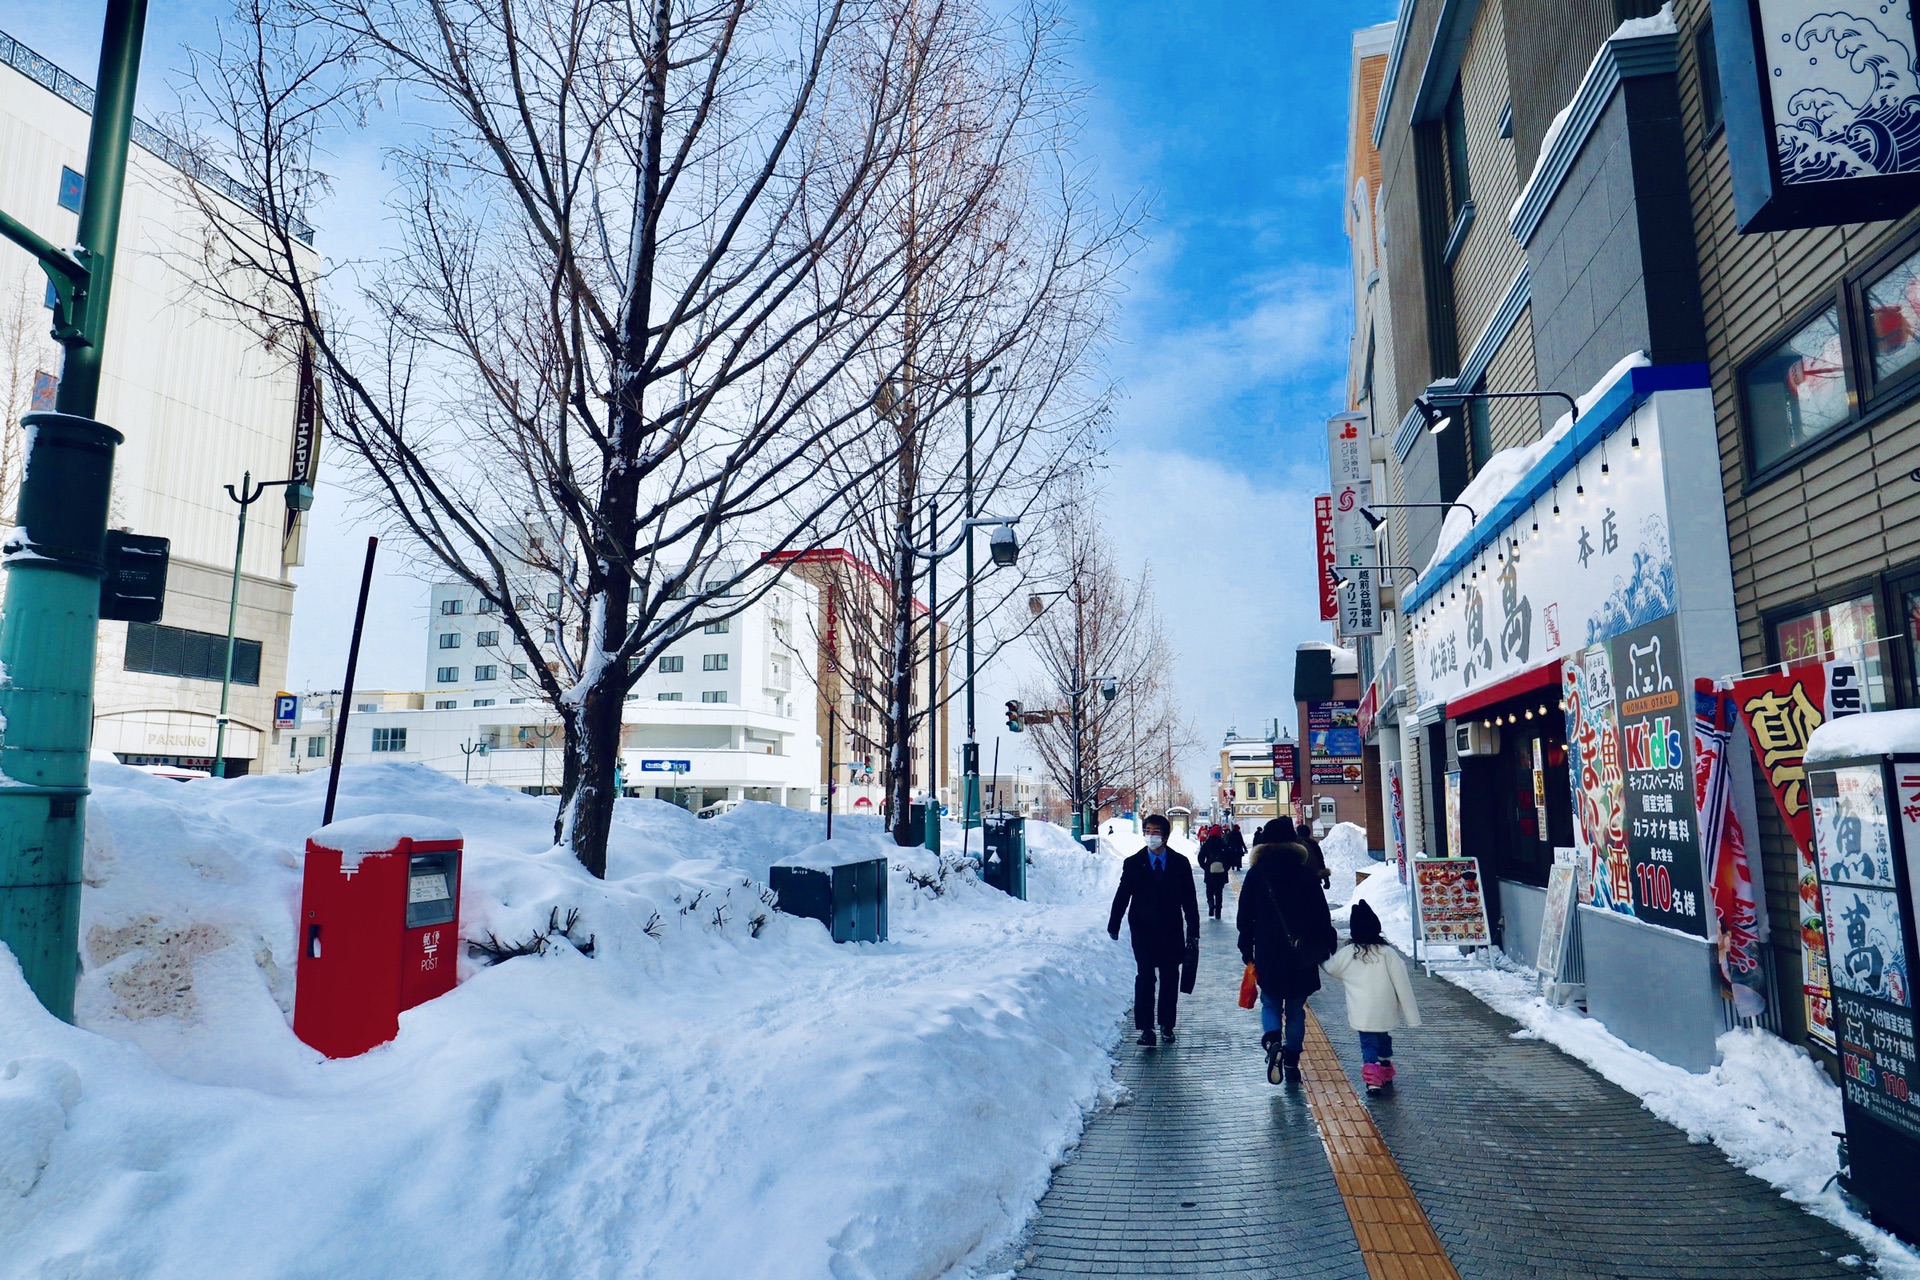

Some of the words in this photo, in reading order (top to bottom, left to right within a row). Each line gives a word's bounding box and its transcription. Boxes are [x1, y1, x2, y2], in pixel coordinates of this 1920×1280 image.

[294, 422, 309, 484] HAPPY
[1341, 442, 1350, 473] クリニック
[1352, 506, 1362, 544] クリニック
[1577, 507, 1618, 569] 本店
[1346, 582, 1358, 628] クリニック
[1358, 570, 1373, 628] 越前谷脳神経
[1463, 537, 1532, 688] 魚萬
[1430, 632, 1458, 682] 北海道
[279, 699, 294, 718] P
[1626, 700, 1648, 712] UOMAN
[1651, 695, 1673, 708] OTARU
[147, 733, 208, 748] PARKING
[1624, 716, 1683, 771] Kid's
[1629, 772, 1684, 791] キッズスペース付
[1239, 805, 1264, 814] KFC
[1600, 729, 1631, 903] 魚と酒
[1642, 794, 1673, 813] 個室完備
[1633, 818, 1689, 842] カラオケ無料
[1871, 805, 1892, 883] 北海道
[1650, 847, 1673, 863] 最大宴会
[1636, 862, 1671, 912] 110
[1672, 888, 1696, 917] 名様
[1815, 807, 1836, 946] ランチやってます
[1830, 796, 1884, 993] 魚萬
[422, 930, 441, 946] 郵便
[420, 957, 438, 972] POST
[1837, 996, 1913, 1038] キッズスペース付個室完備
[1873, 1030, 1916, 1062] カラオケ無料
[1843, 1052, 1877, 1087] Kid's
[1875, 1053, 1906, 1076] 最大宴会
[1882, 1071, 1908, 1102] 110
